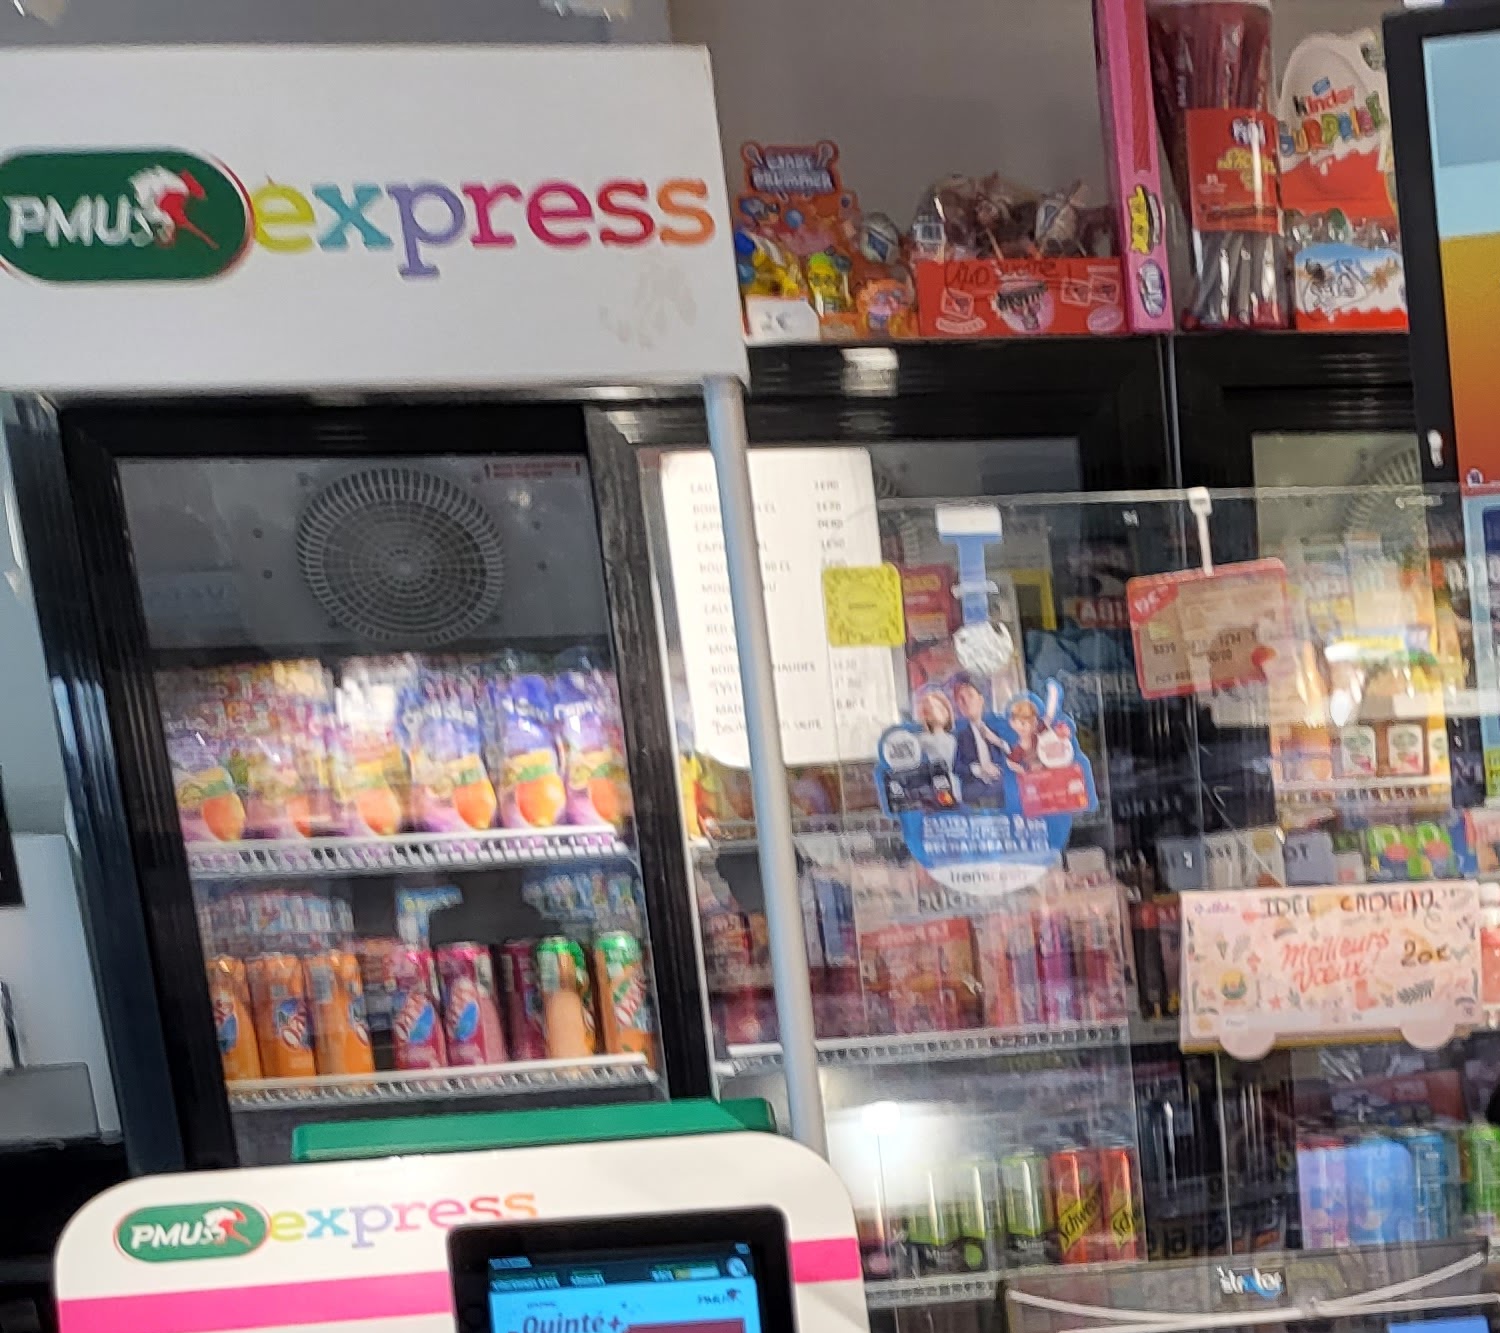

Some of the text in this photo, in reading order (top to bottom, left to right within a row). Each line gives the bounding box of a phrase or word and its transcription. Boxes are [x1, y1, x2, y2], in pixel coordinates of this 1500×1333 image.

[1292, 86, 1355, 117] kinder
[8, 177, 716, 279] PMU express
[131, 1192, 539, 1250] PMU express
